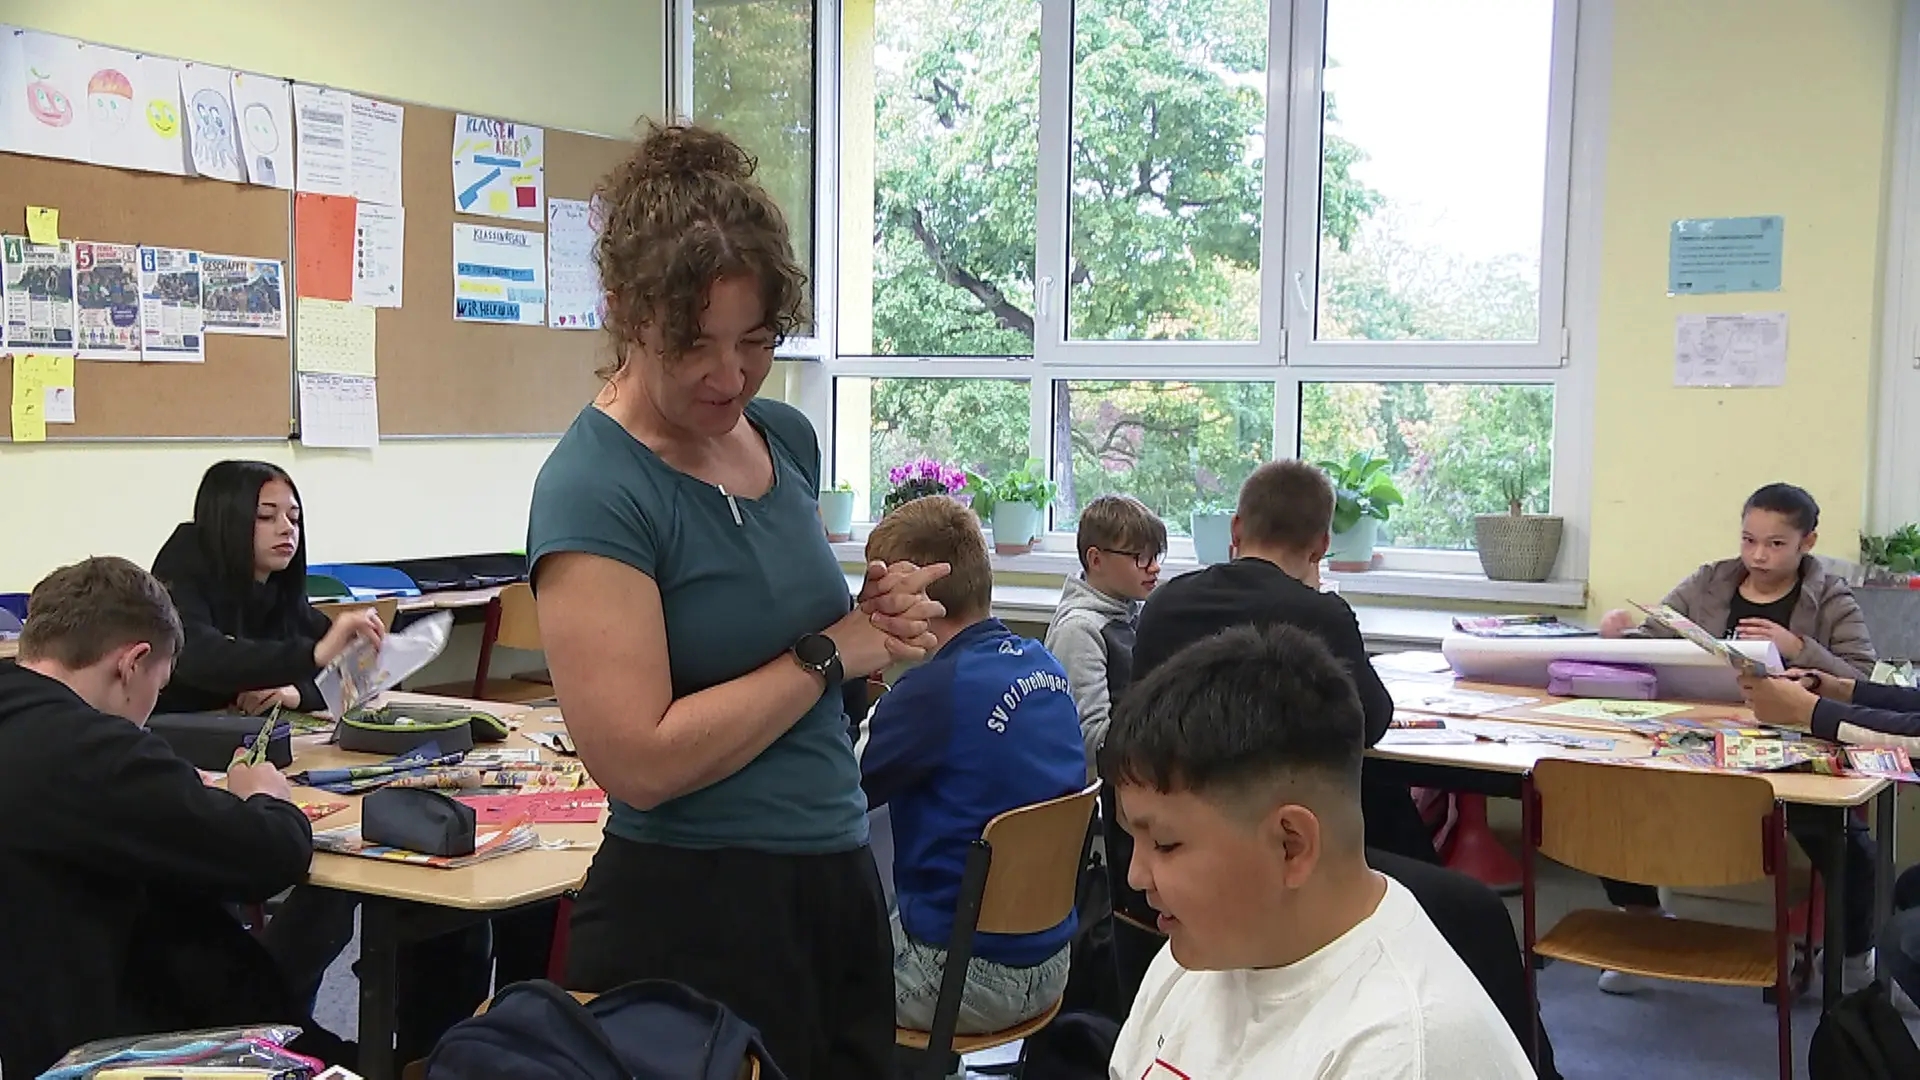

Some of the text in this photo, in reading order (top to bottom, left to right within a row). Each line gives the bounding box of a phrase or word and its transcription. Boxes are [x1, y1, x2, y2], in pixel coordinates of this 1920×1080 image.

[466, 116, 514, 139] KLASSEN
[9, 241, 19, 262] 4
[80, 251, 90, 267] 5
[144, 254, 153, 270] 6
[987, 705, 1009, 733] SV
